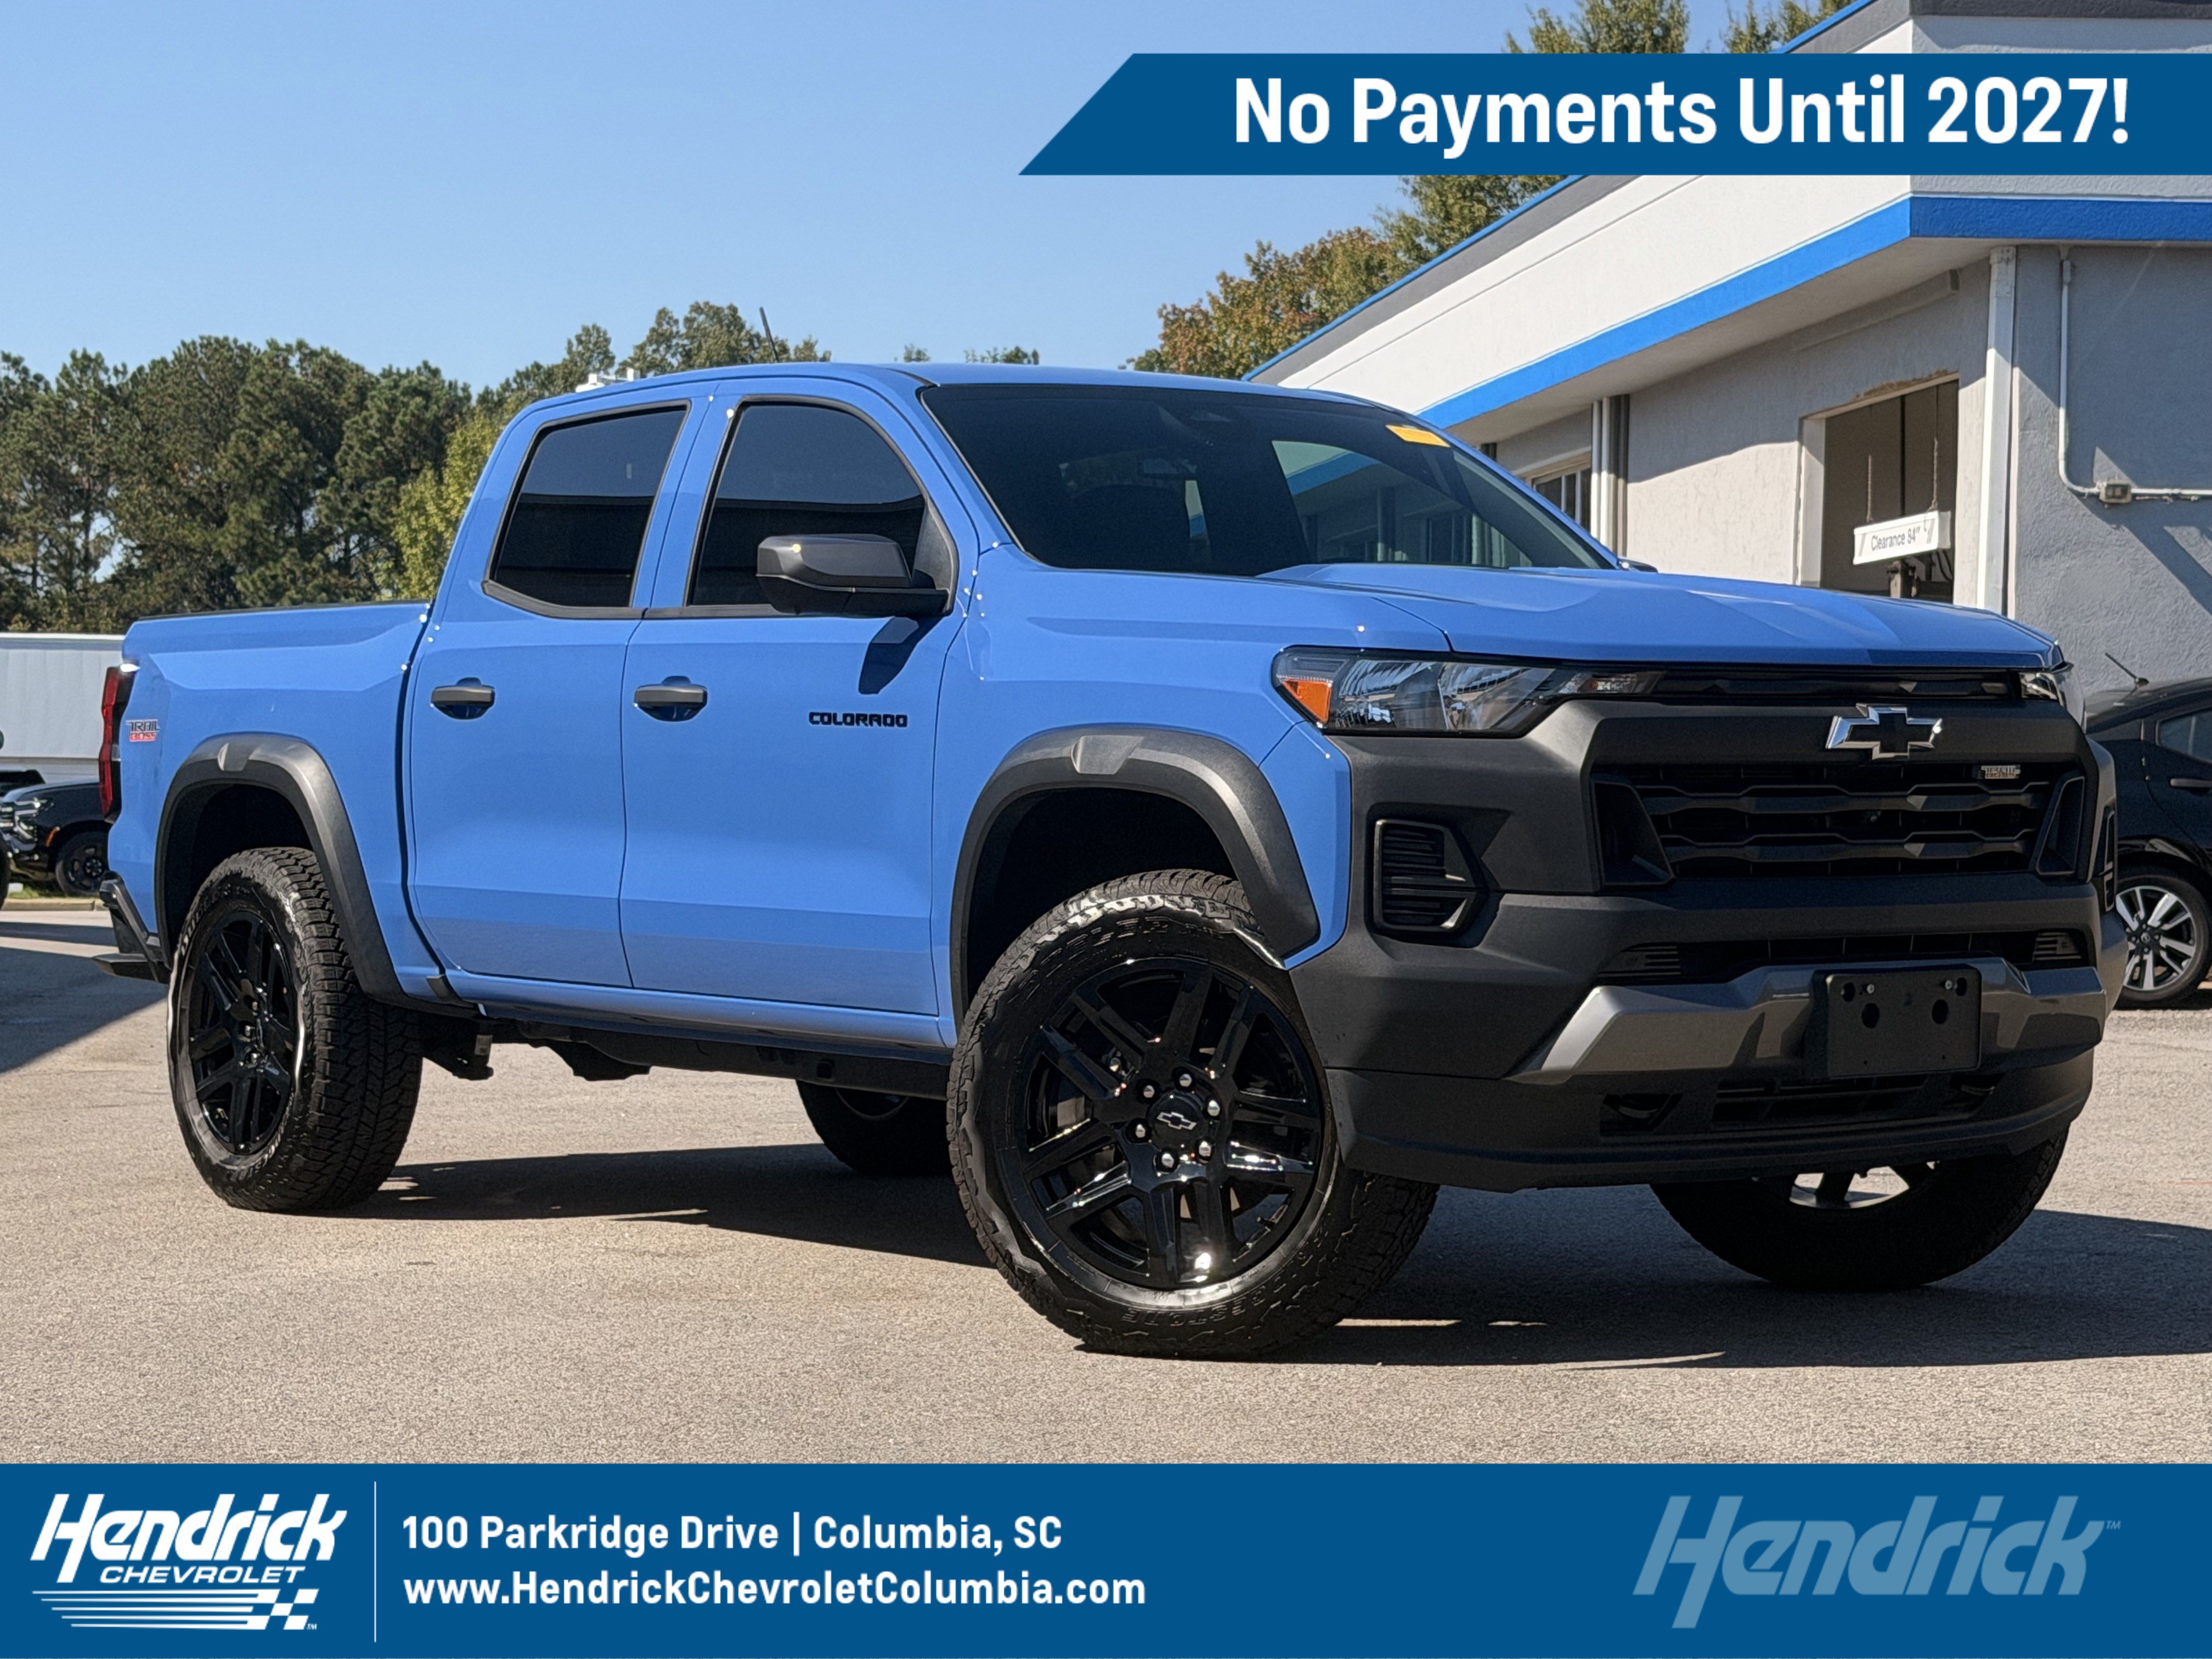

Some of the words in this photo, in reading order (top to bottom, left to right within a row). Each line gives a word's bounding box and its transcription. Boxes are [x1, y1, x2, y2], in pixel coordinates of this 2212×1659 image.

[1871, 532, 1906, 551] Clearance
[126, 719, 160, 732] TRAIL
[809, 712, 908, 727] COLORADO
